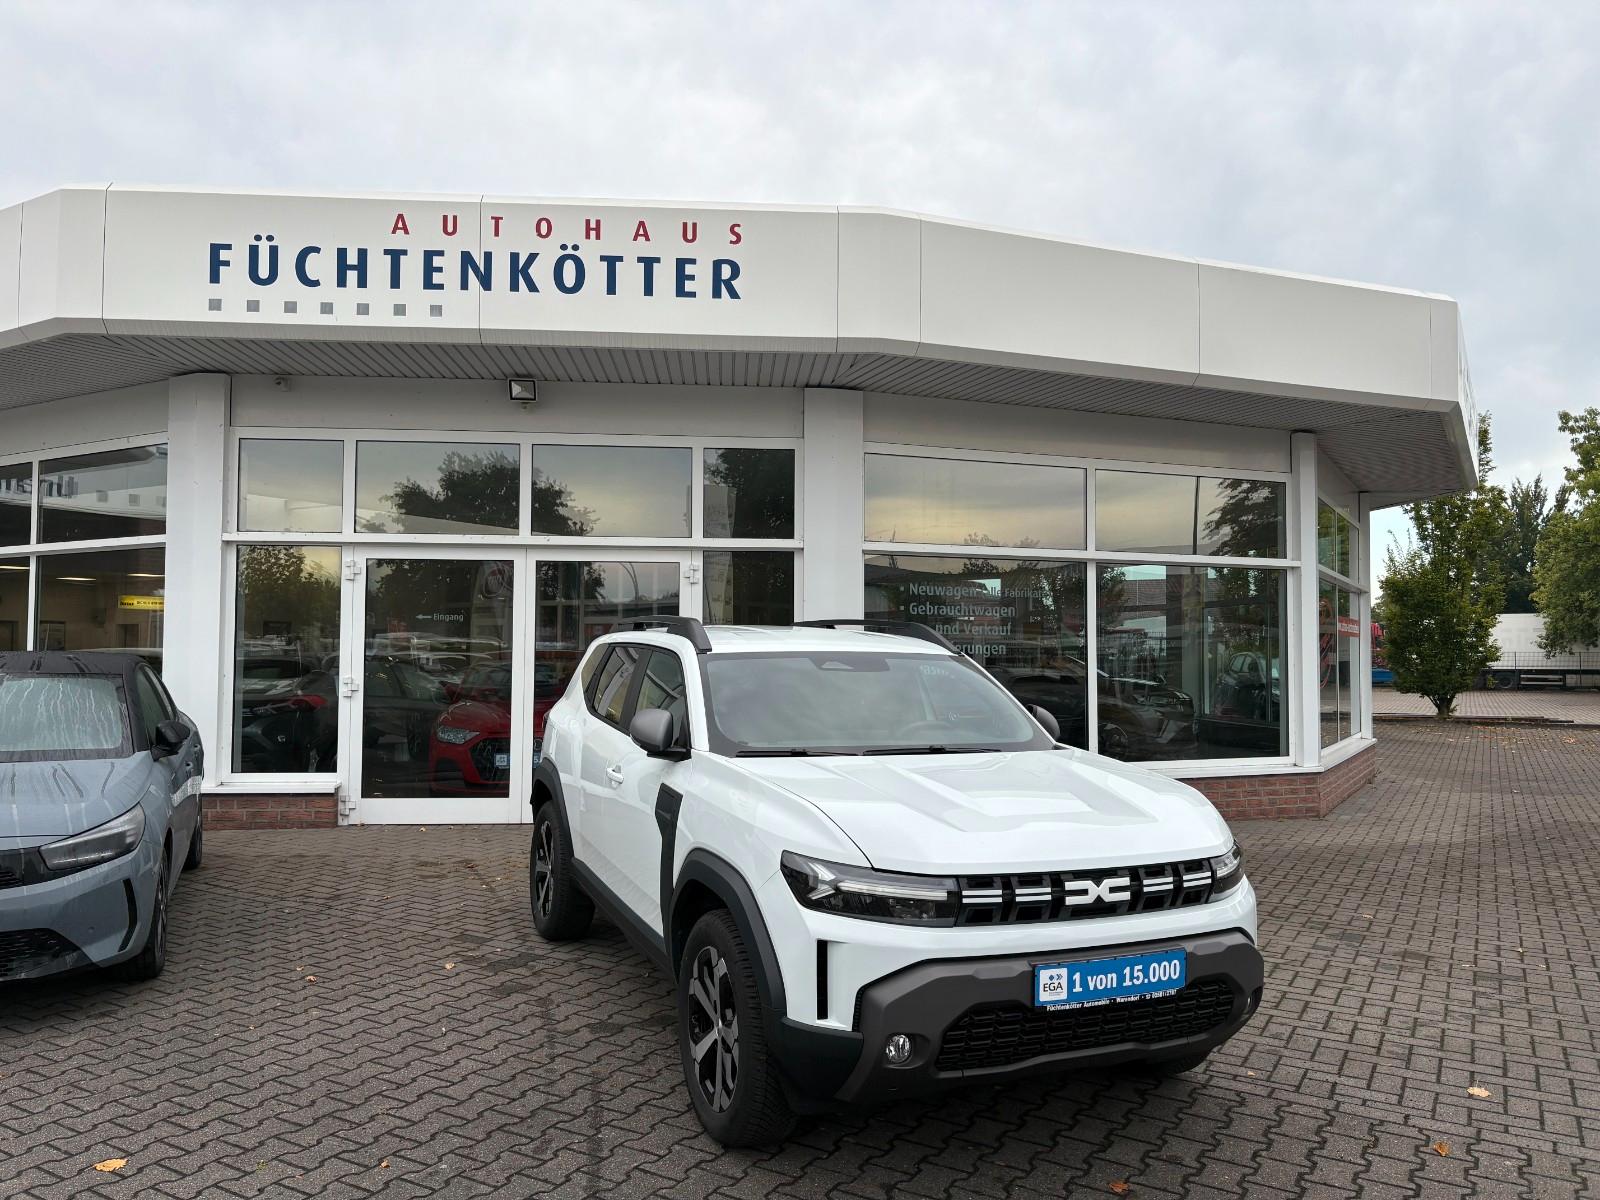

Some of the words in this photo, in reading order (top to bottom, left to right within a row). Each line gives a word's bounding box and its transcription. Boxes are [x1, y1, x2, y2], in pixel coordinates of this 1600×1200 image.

[391, 213, 743, 245] AUTOHAUS
[209, 234, 742, 300] FÜCHTENKÖTTER
[909, 583, 977, 599] Neuwagen
[433, 613, 464, 622] Eingang
[909, 602, 1016, 618] Gebrauchtwagen
[963, 623, 1012, 636] Verkauf
[1072, 972, 1083, 993] 1
[1087, 972, 1117, 991] von
[1122, 959, 1181, 987] 15.000
[1042, 982, 1064, 993] EGA
